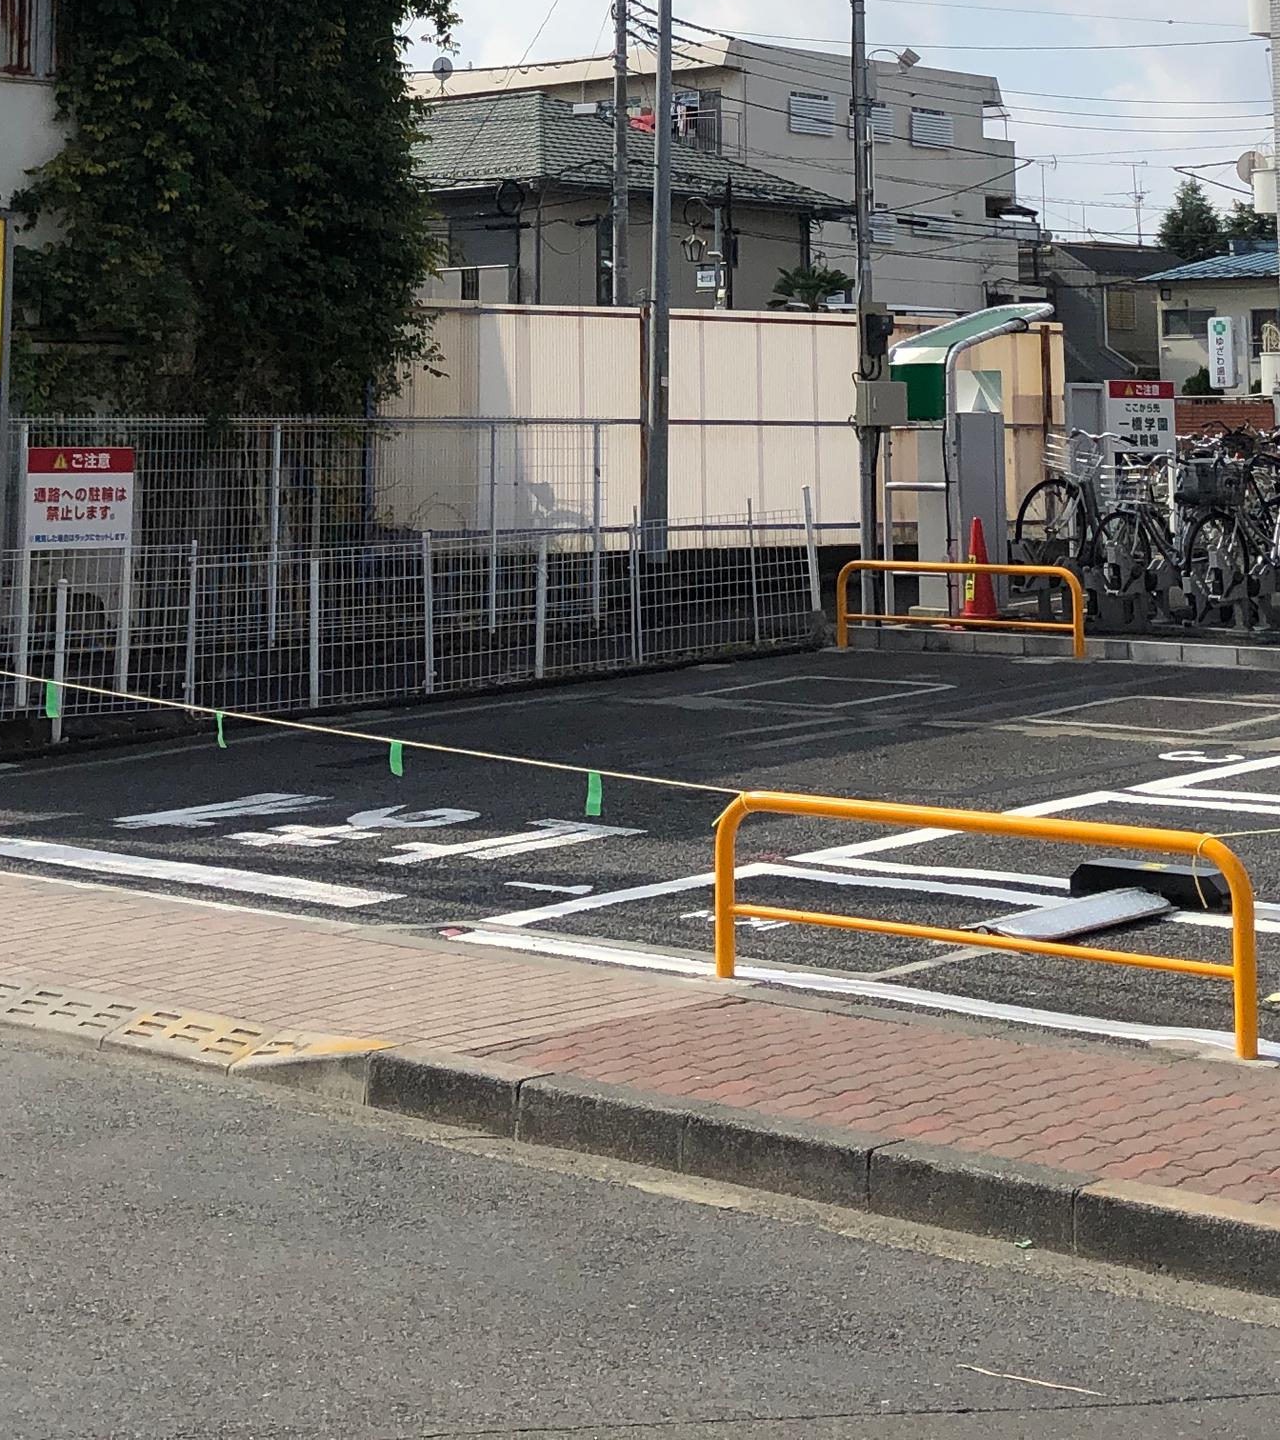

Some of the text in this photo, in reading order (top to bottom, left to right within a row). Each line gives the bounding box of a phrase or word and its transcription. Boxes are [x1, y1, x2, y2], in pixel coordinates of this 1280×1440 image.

[1119, 417, 1169, 431] 一橋学園
[71, 452, 111, 469] ご注意
[33, 486, 127, 503] 通路への駐輪は
[46, 505, 116, 521] 禁止します。
